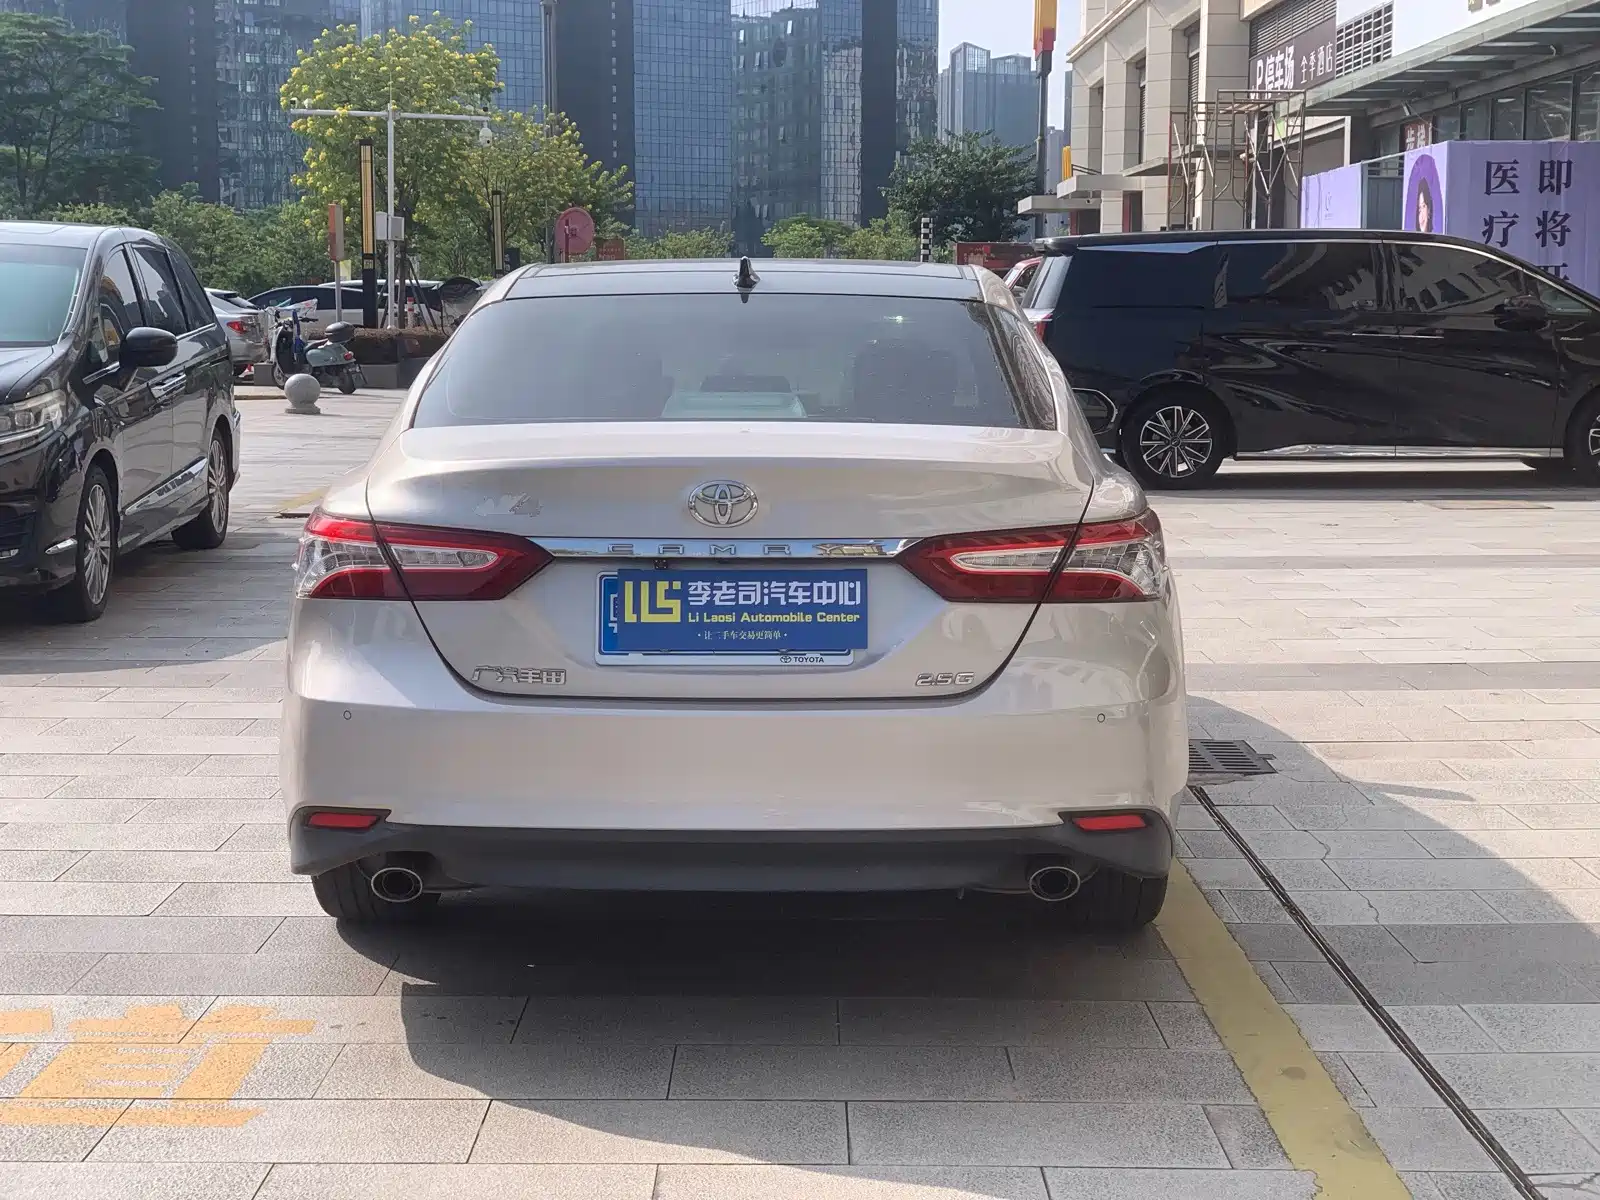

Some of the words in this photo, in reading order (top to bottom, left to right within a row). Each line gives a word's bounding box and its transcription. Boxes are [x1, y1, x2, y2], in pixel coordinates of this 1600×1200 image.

[1300, 42, 1333, 84] 全季酒店
[1481, 159, 1520, 248] 医疗
[607, 543, 838, 556] CAMRY
[687, 581, 861, 605] 李老司汽车中心
[688, 612, 699, 622] Li
[703, 612, 735, 622] Laosi
[740, 612, 812, 622] Automobile
[817, 612, 860, 622] Center
[472, 664, 566, 685] 广汽丰田
[915, 672, 974, 686] 2.5G
